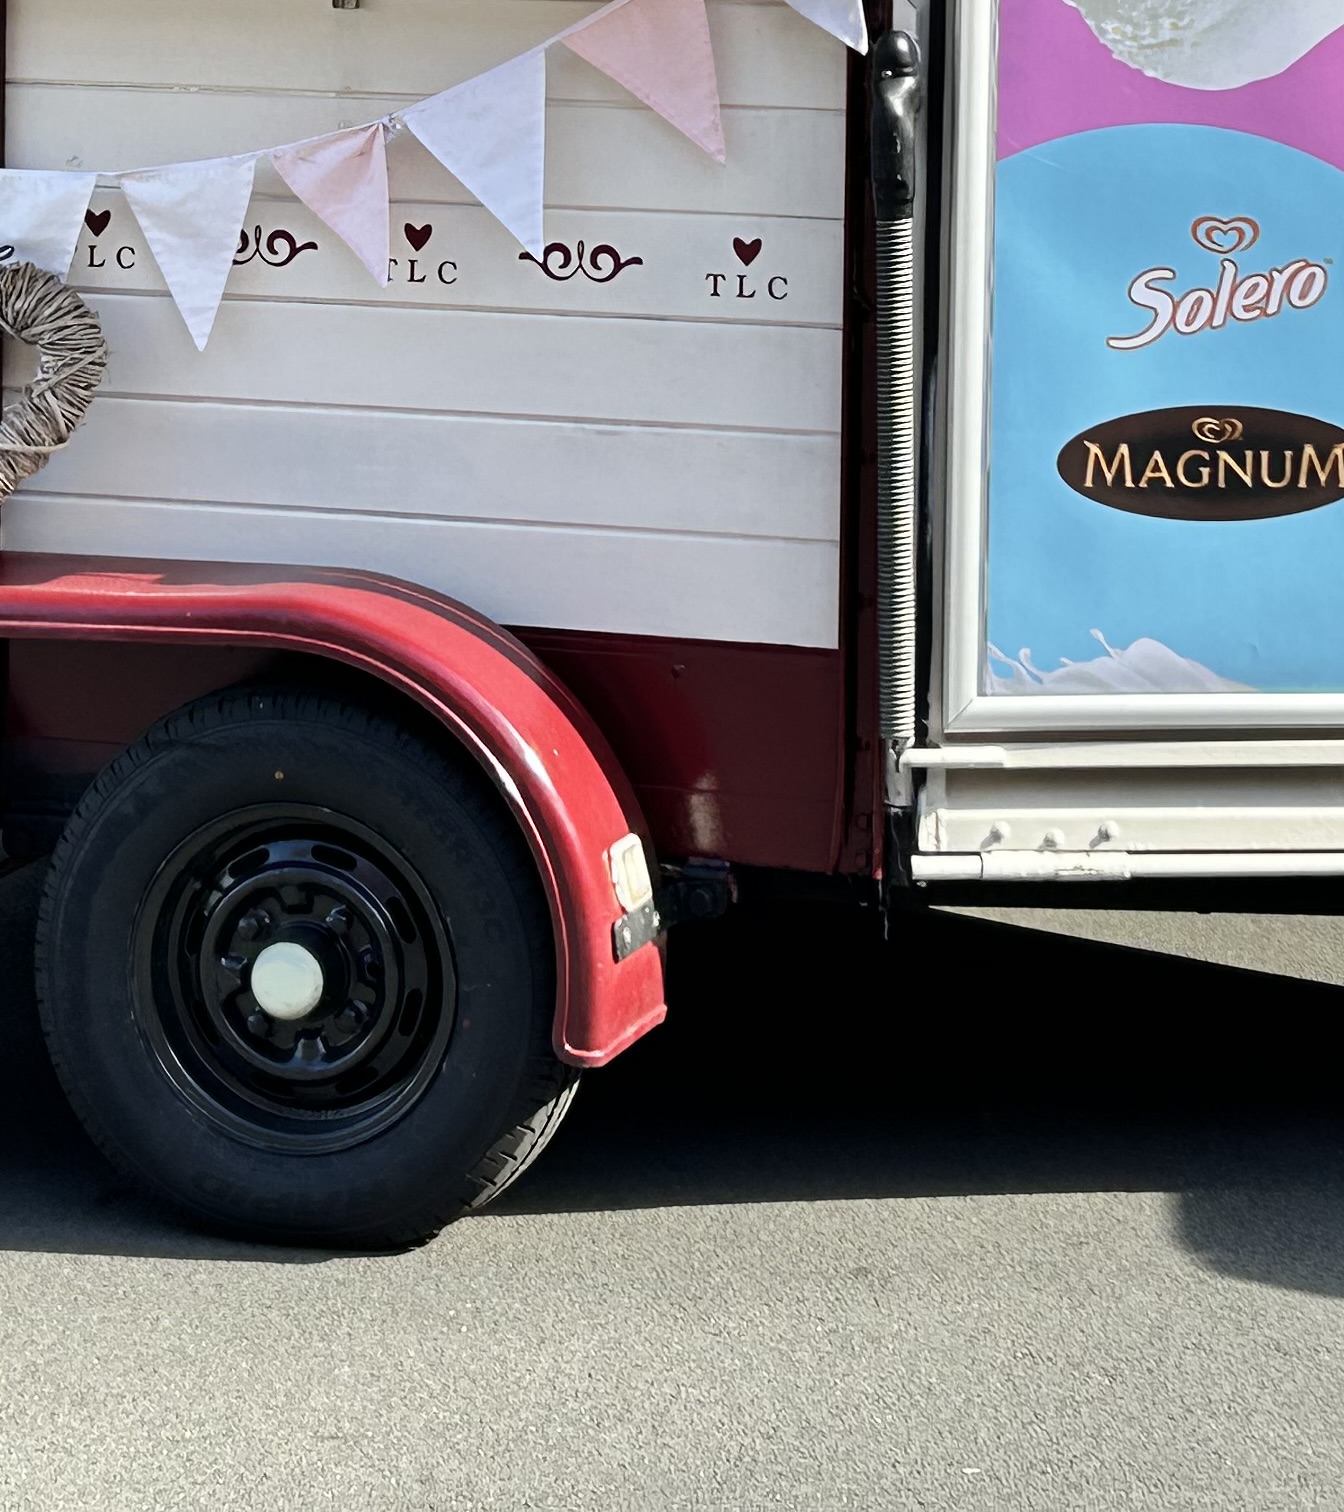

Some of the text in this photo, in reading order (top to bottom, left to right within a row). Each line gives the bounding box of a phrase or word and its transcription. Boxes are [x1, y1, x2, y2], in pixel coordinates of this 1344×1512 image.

[74, 244, 137, 270] LC
[705, 272, 789, 301] TLC
[1105, 257, 1328, 351] Solero
